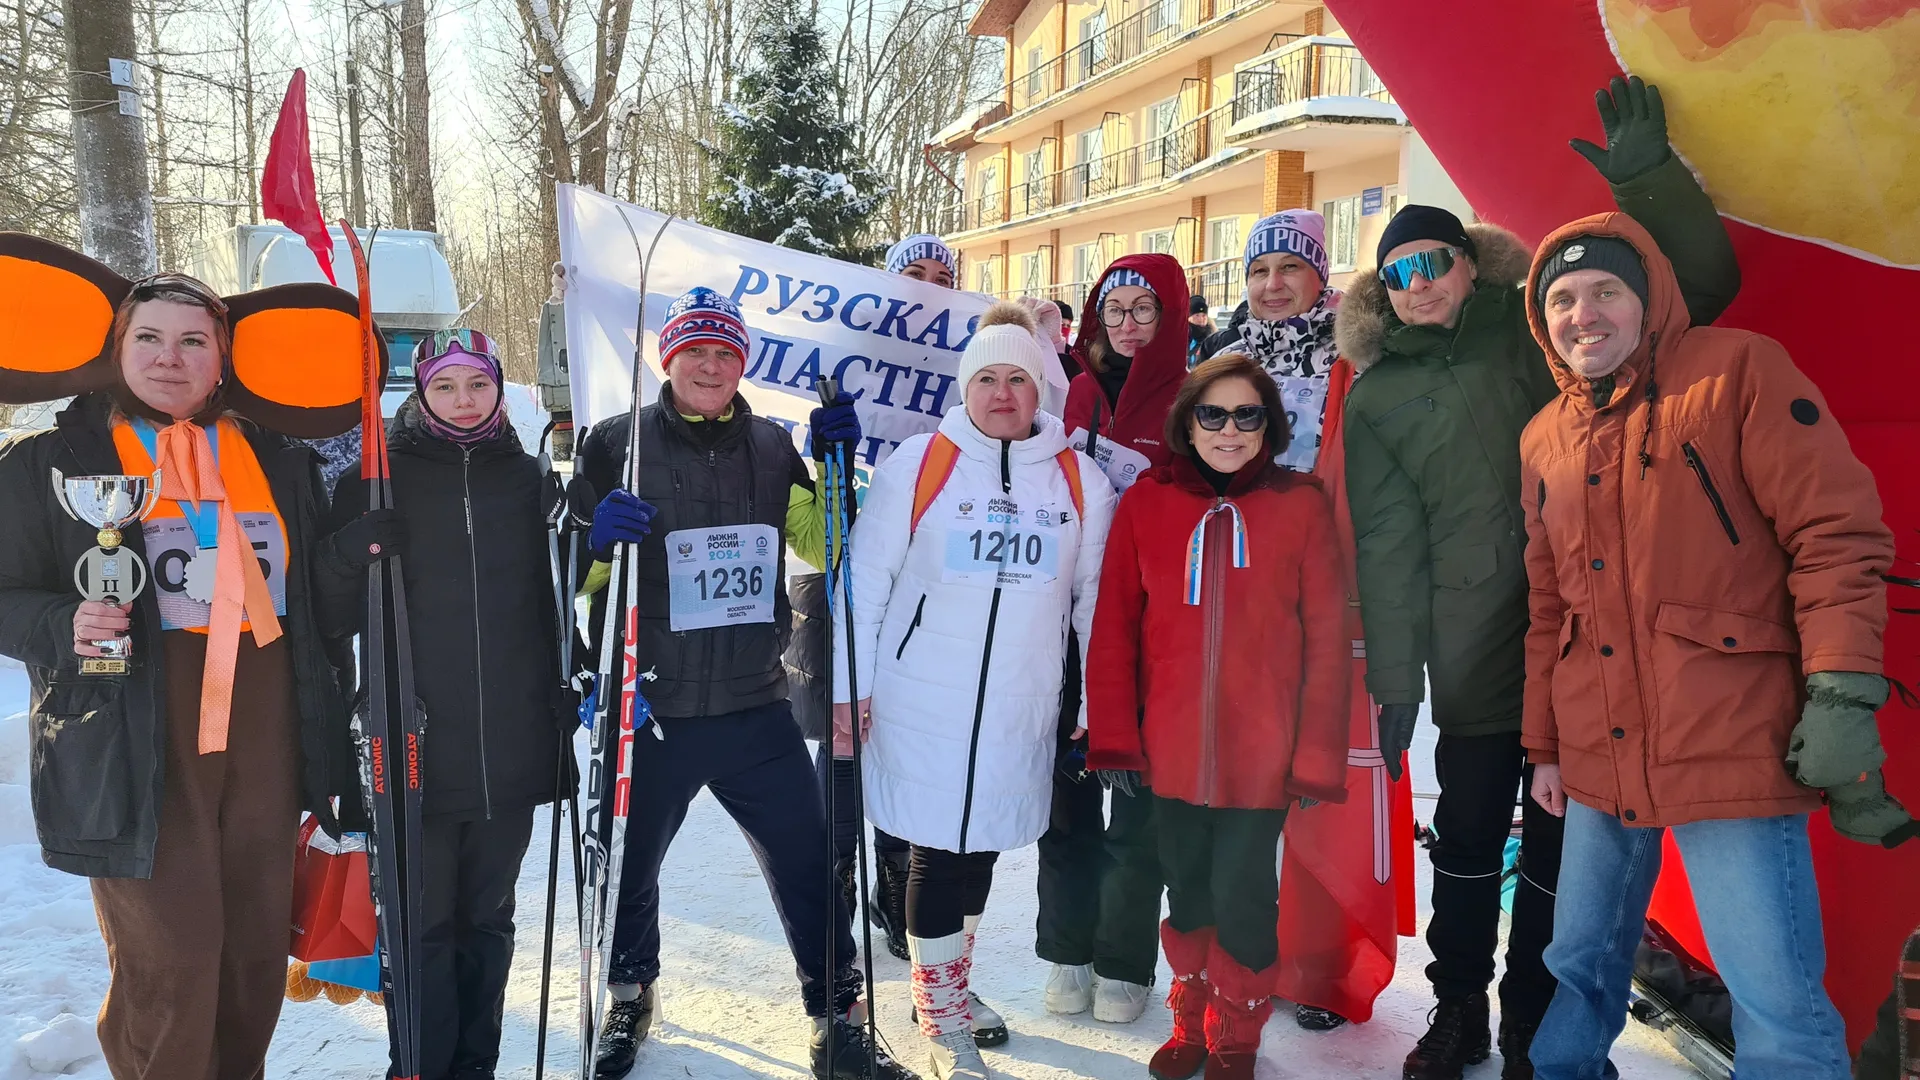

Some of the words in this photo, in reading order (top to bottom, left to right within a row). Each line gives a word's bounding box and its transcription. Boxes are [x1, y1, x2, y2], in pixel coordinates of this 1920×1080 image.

[362, 327, 371, 394] ATOMIC
[744, 336, 957, 419] ЛАСТН
[987, 498, 1018, 509] ЛЫЖНЯ
[987, 506, 1018, 515] РОССИИ
[987, 514, 1020, 524] 2024
[706, 532, 738, 542] ЛЫЖНЯ
[707, 540, 739, 550] РОССИИ
[969, 529, 1042, 566] 1210
[708, 549, 741, 561] 2024
[997, 571, 1032, 579] МОСКОВСКАЯ
[694, 565, 763, 601] 1236
[997, 577, 1021, 585] ОБЛАСТЬ
[726, 604, 756, 612] МОСКОВСКАЯ
[613, 604, 639, 817] SABLE
[372, 736, 384, 794] ATOMIC
[407, 732, 419, 790] ATOMIC
